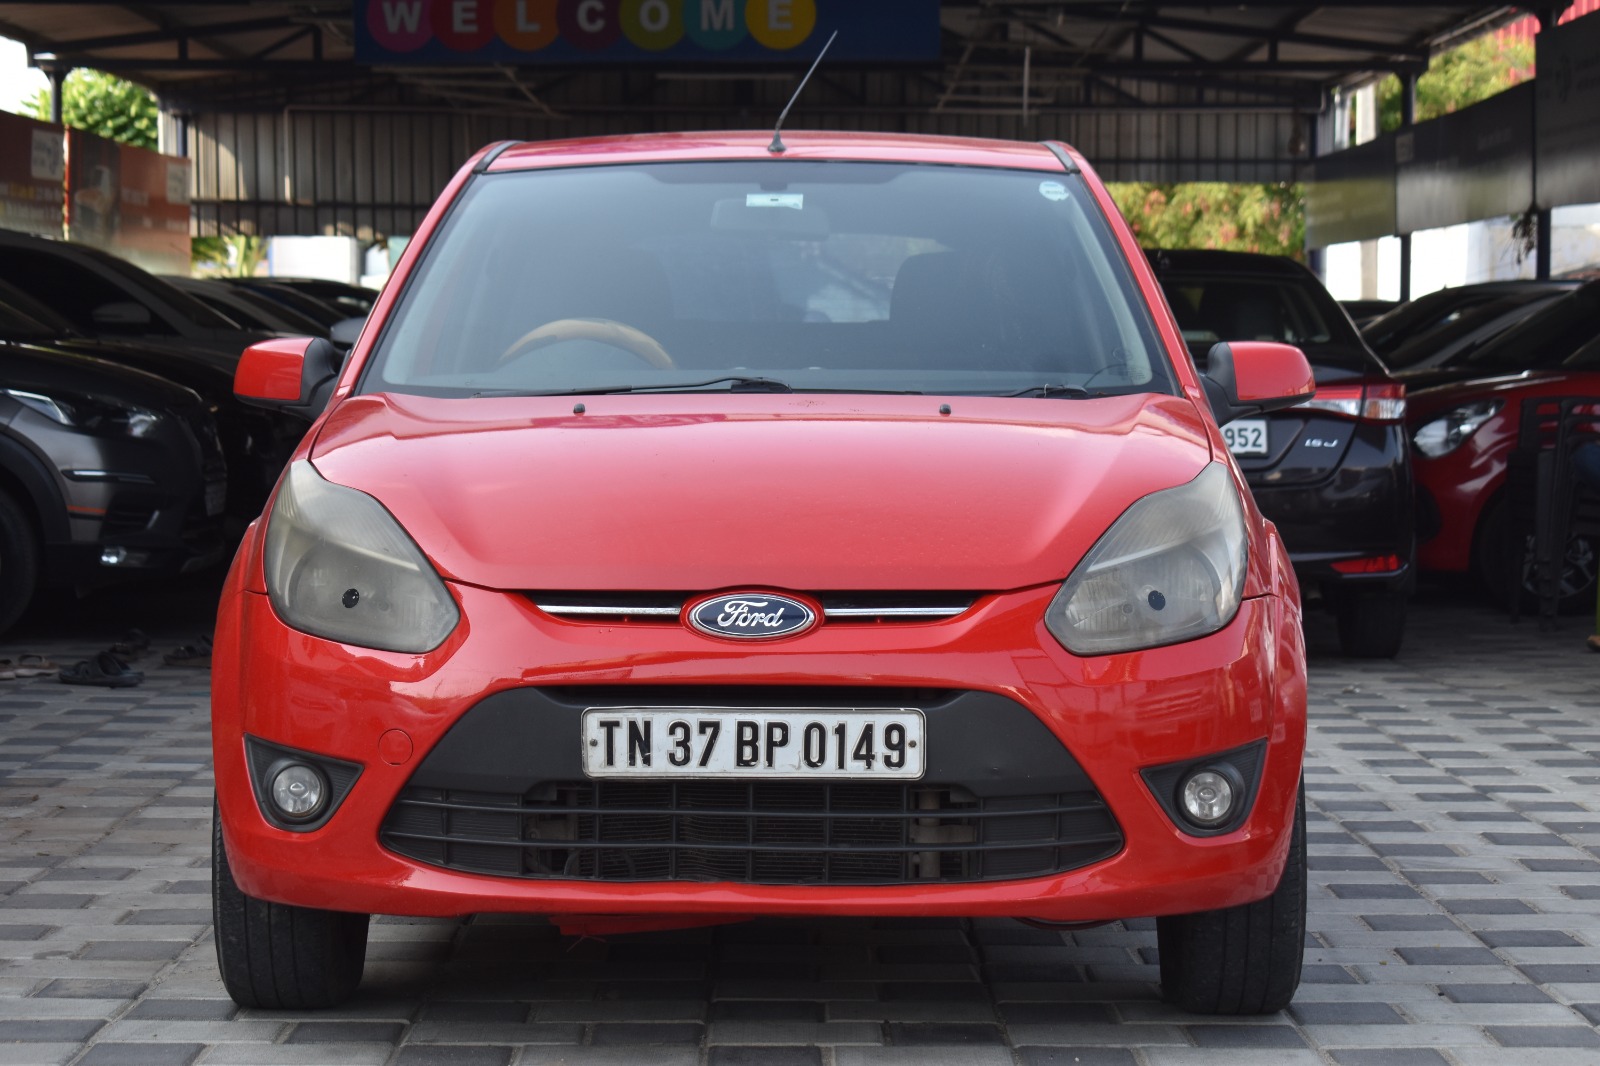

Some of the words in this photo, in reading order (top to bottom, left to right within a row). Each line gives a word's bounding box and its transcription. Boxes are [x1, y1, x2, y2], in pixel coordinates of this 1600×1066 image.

[381, 0, 794, 33] WELCOME
[1225, 428, 1262, 447] 952
[717, 601, 785, 626] Ford
[599, 719, 651, 767] TN
[666, 719, 721, 767] 37
[735, 721, 789, 768] BP
[803, 721, 906, 769] 0149
